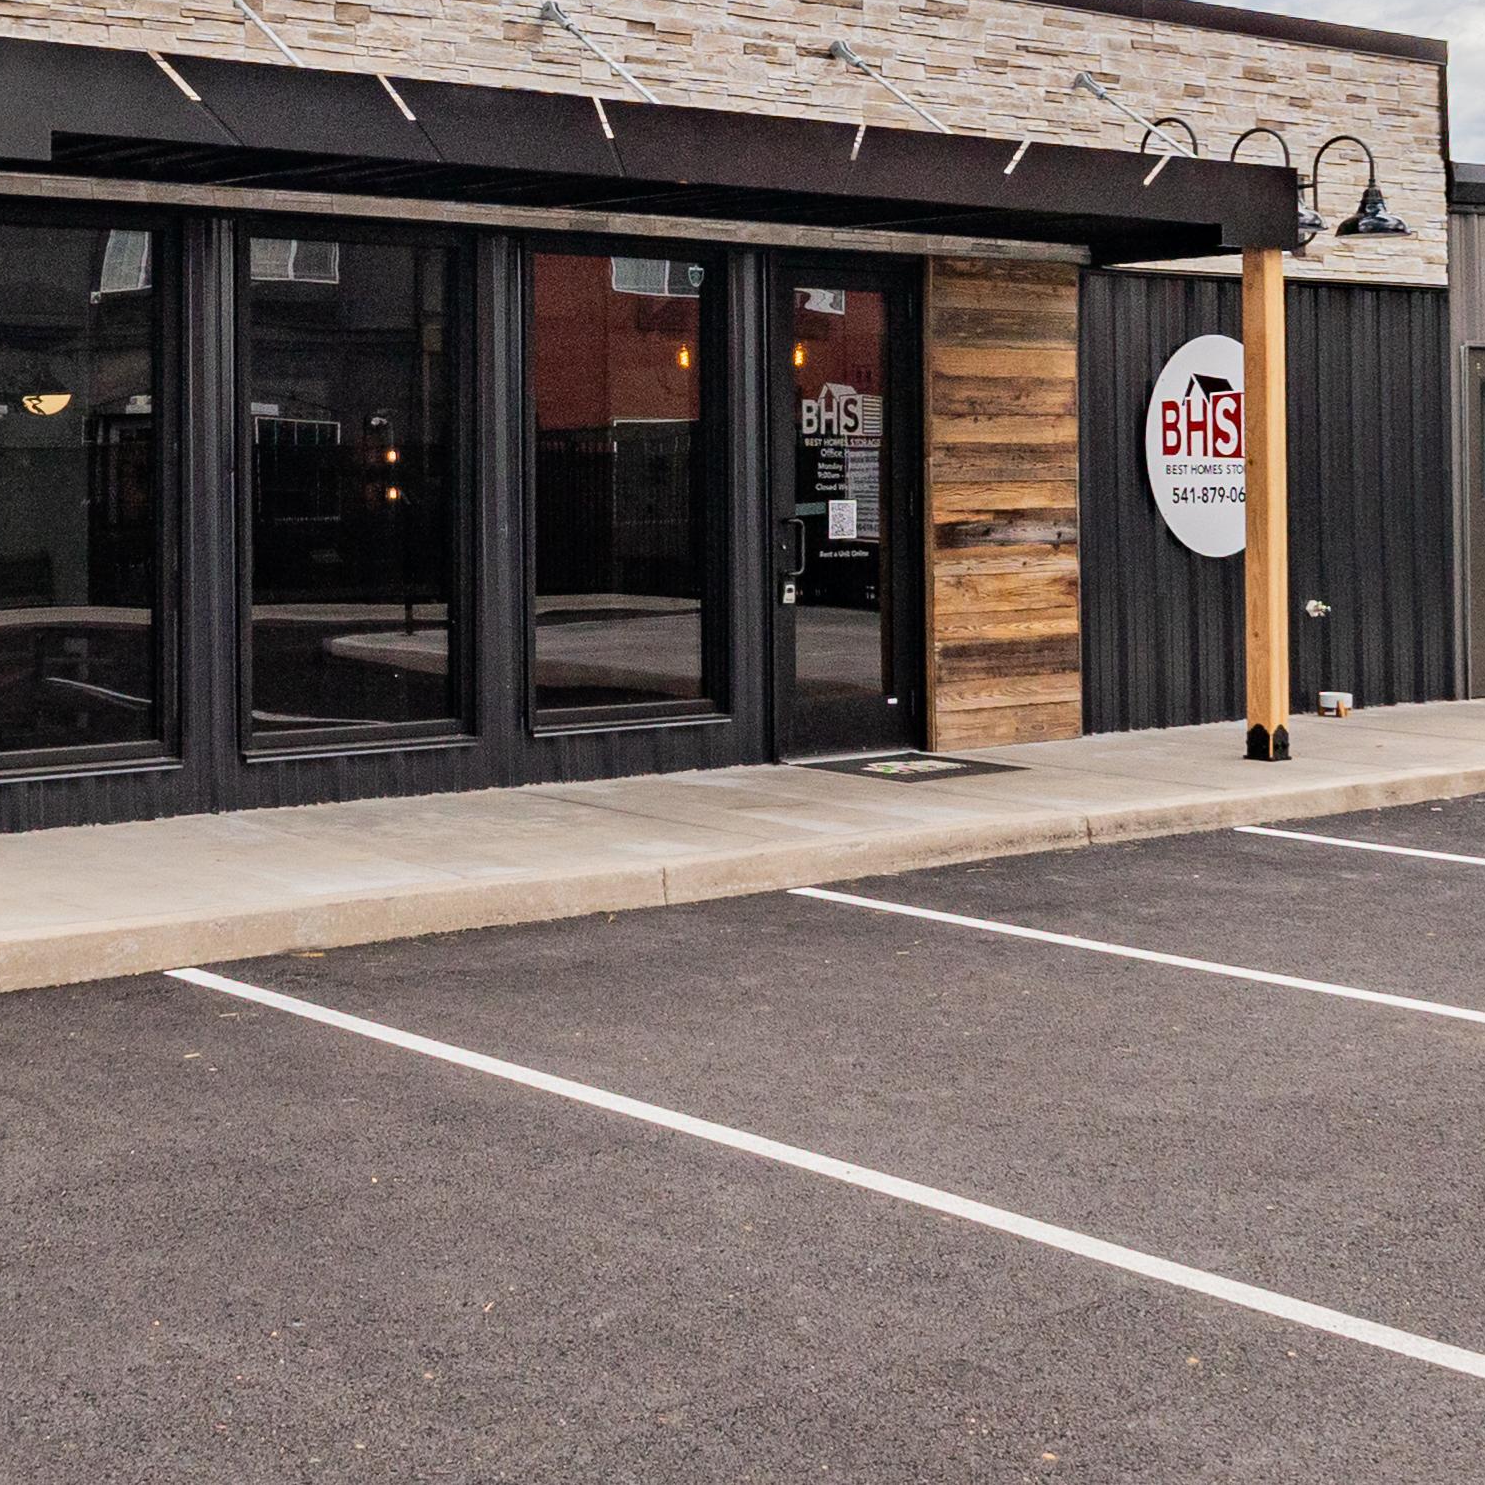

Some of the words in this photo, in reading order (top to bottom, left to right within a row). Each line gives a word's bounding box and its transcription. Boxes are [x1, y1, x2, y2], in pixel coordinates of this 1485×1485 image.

[802, 395, 861, 435] BHS
[1162, 393, 1242, 458] BHS
[1166, 464, 1188, 475] BEST
[1191, 464, 1223, 475] HOMES
[1172, 486, 1246, 504] 541-879-06
